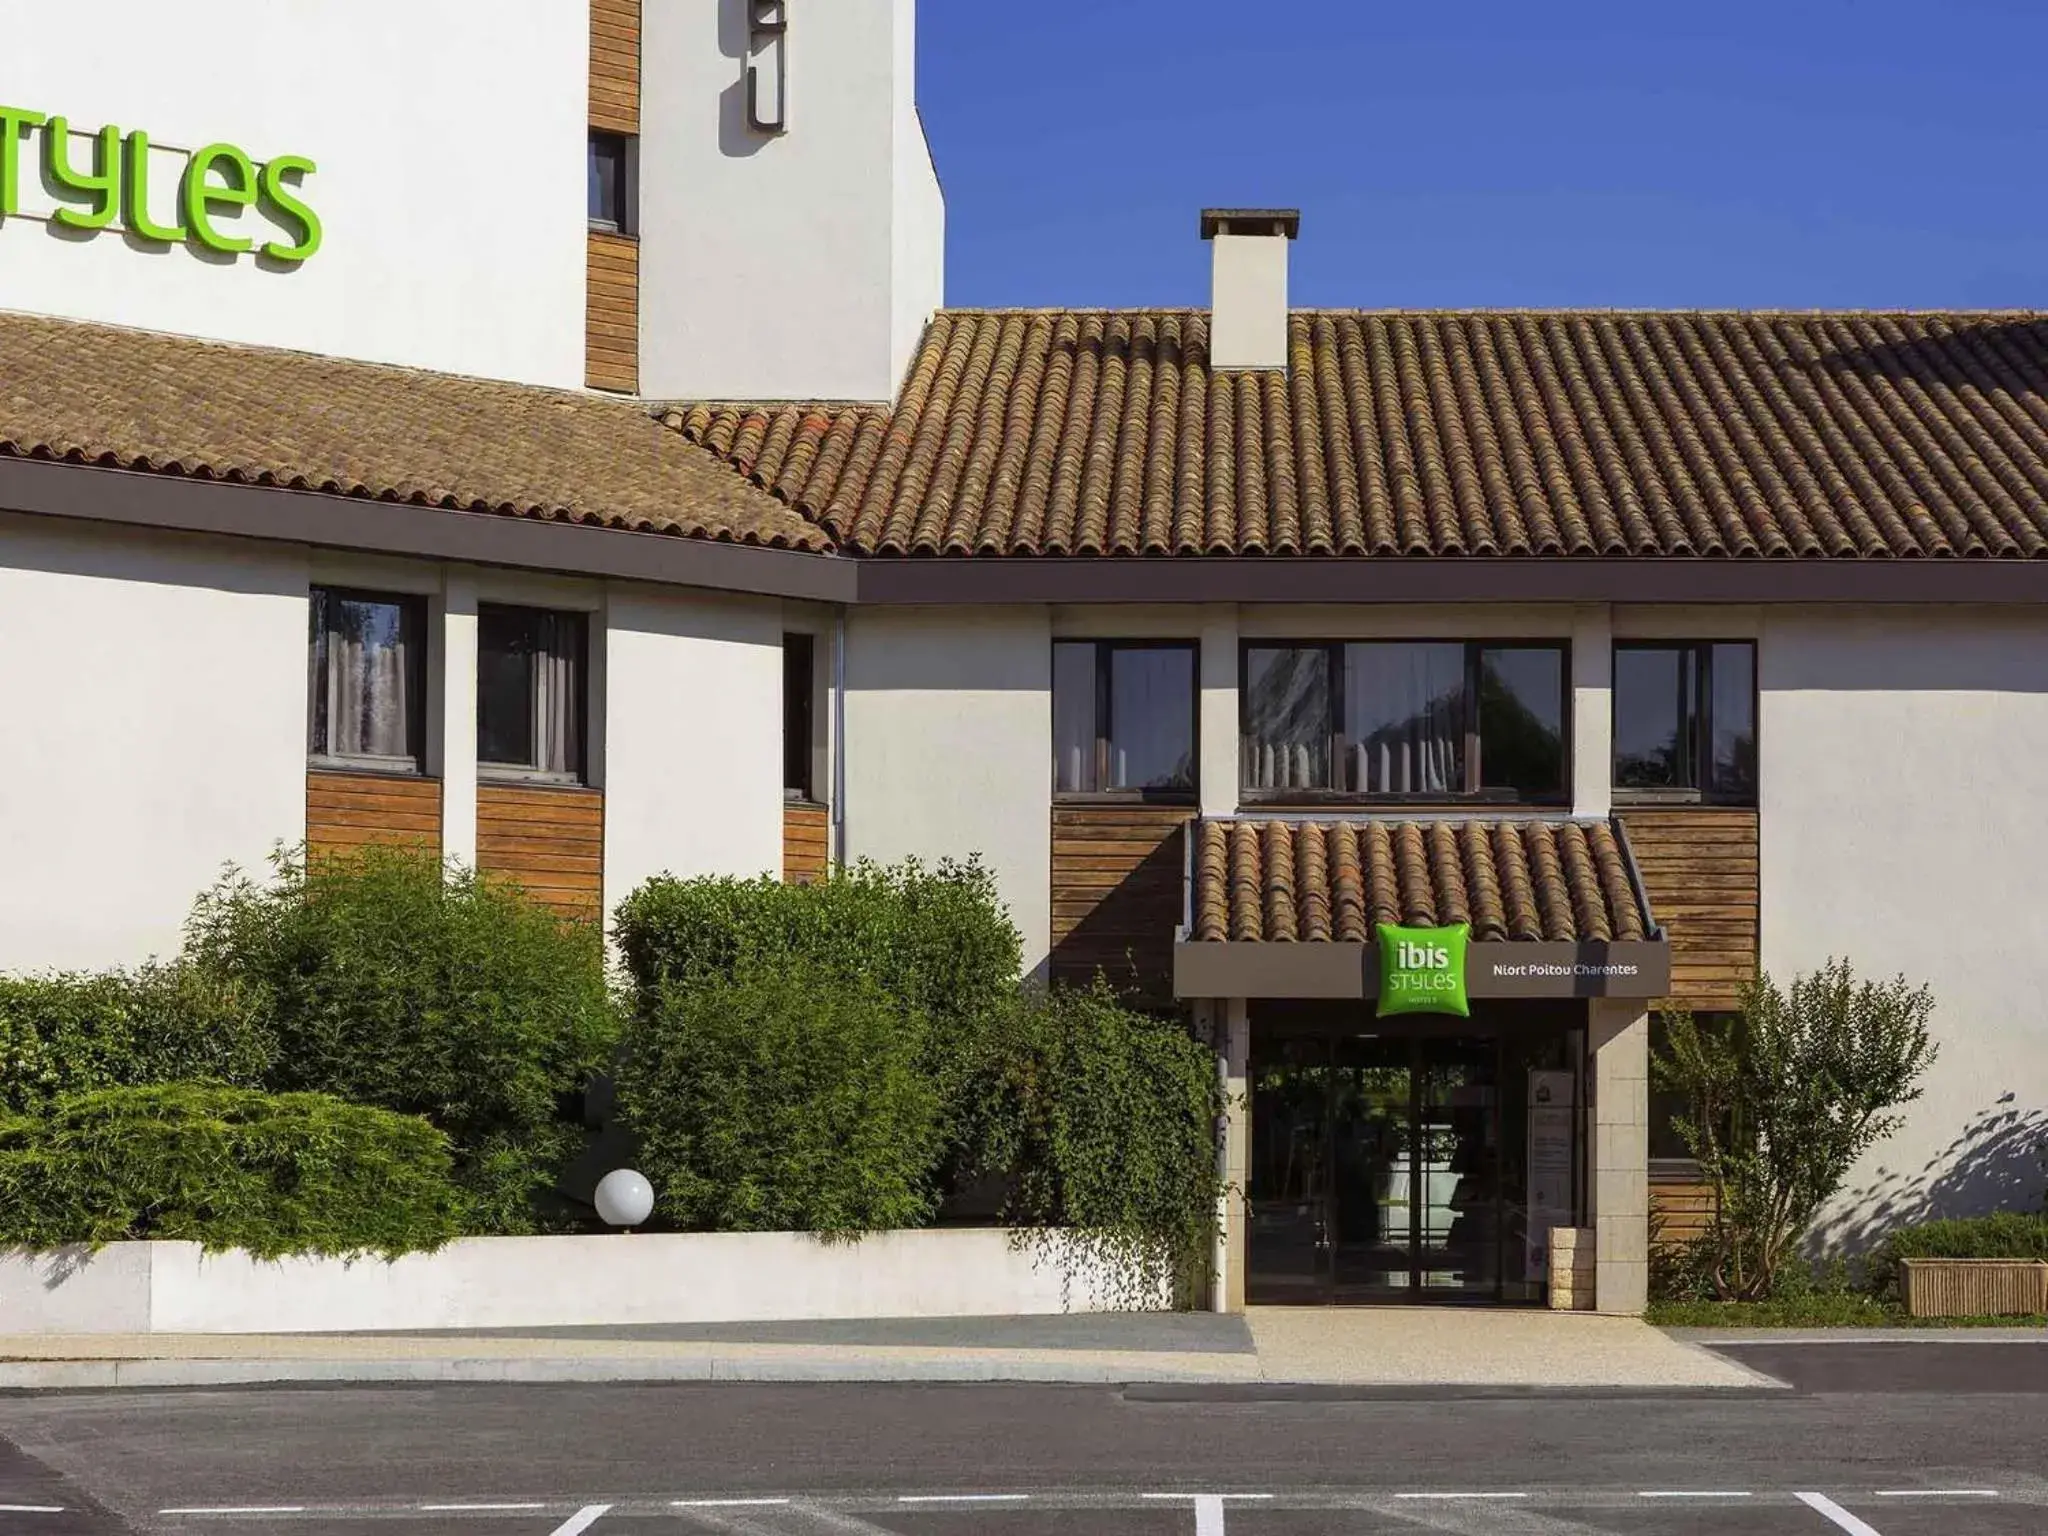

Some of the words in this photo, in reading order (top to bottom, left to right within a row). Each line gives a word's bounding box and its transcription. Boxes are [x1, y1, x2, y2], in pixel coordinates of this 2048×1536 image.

[1398, 941, 1449, 969] ibis
[1493, 963, 1527, 976] Niort
[1529, 963, 1571, 976] Poitou
[1573, 963, 1638, 976] Charentes
